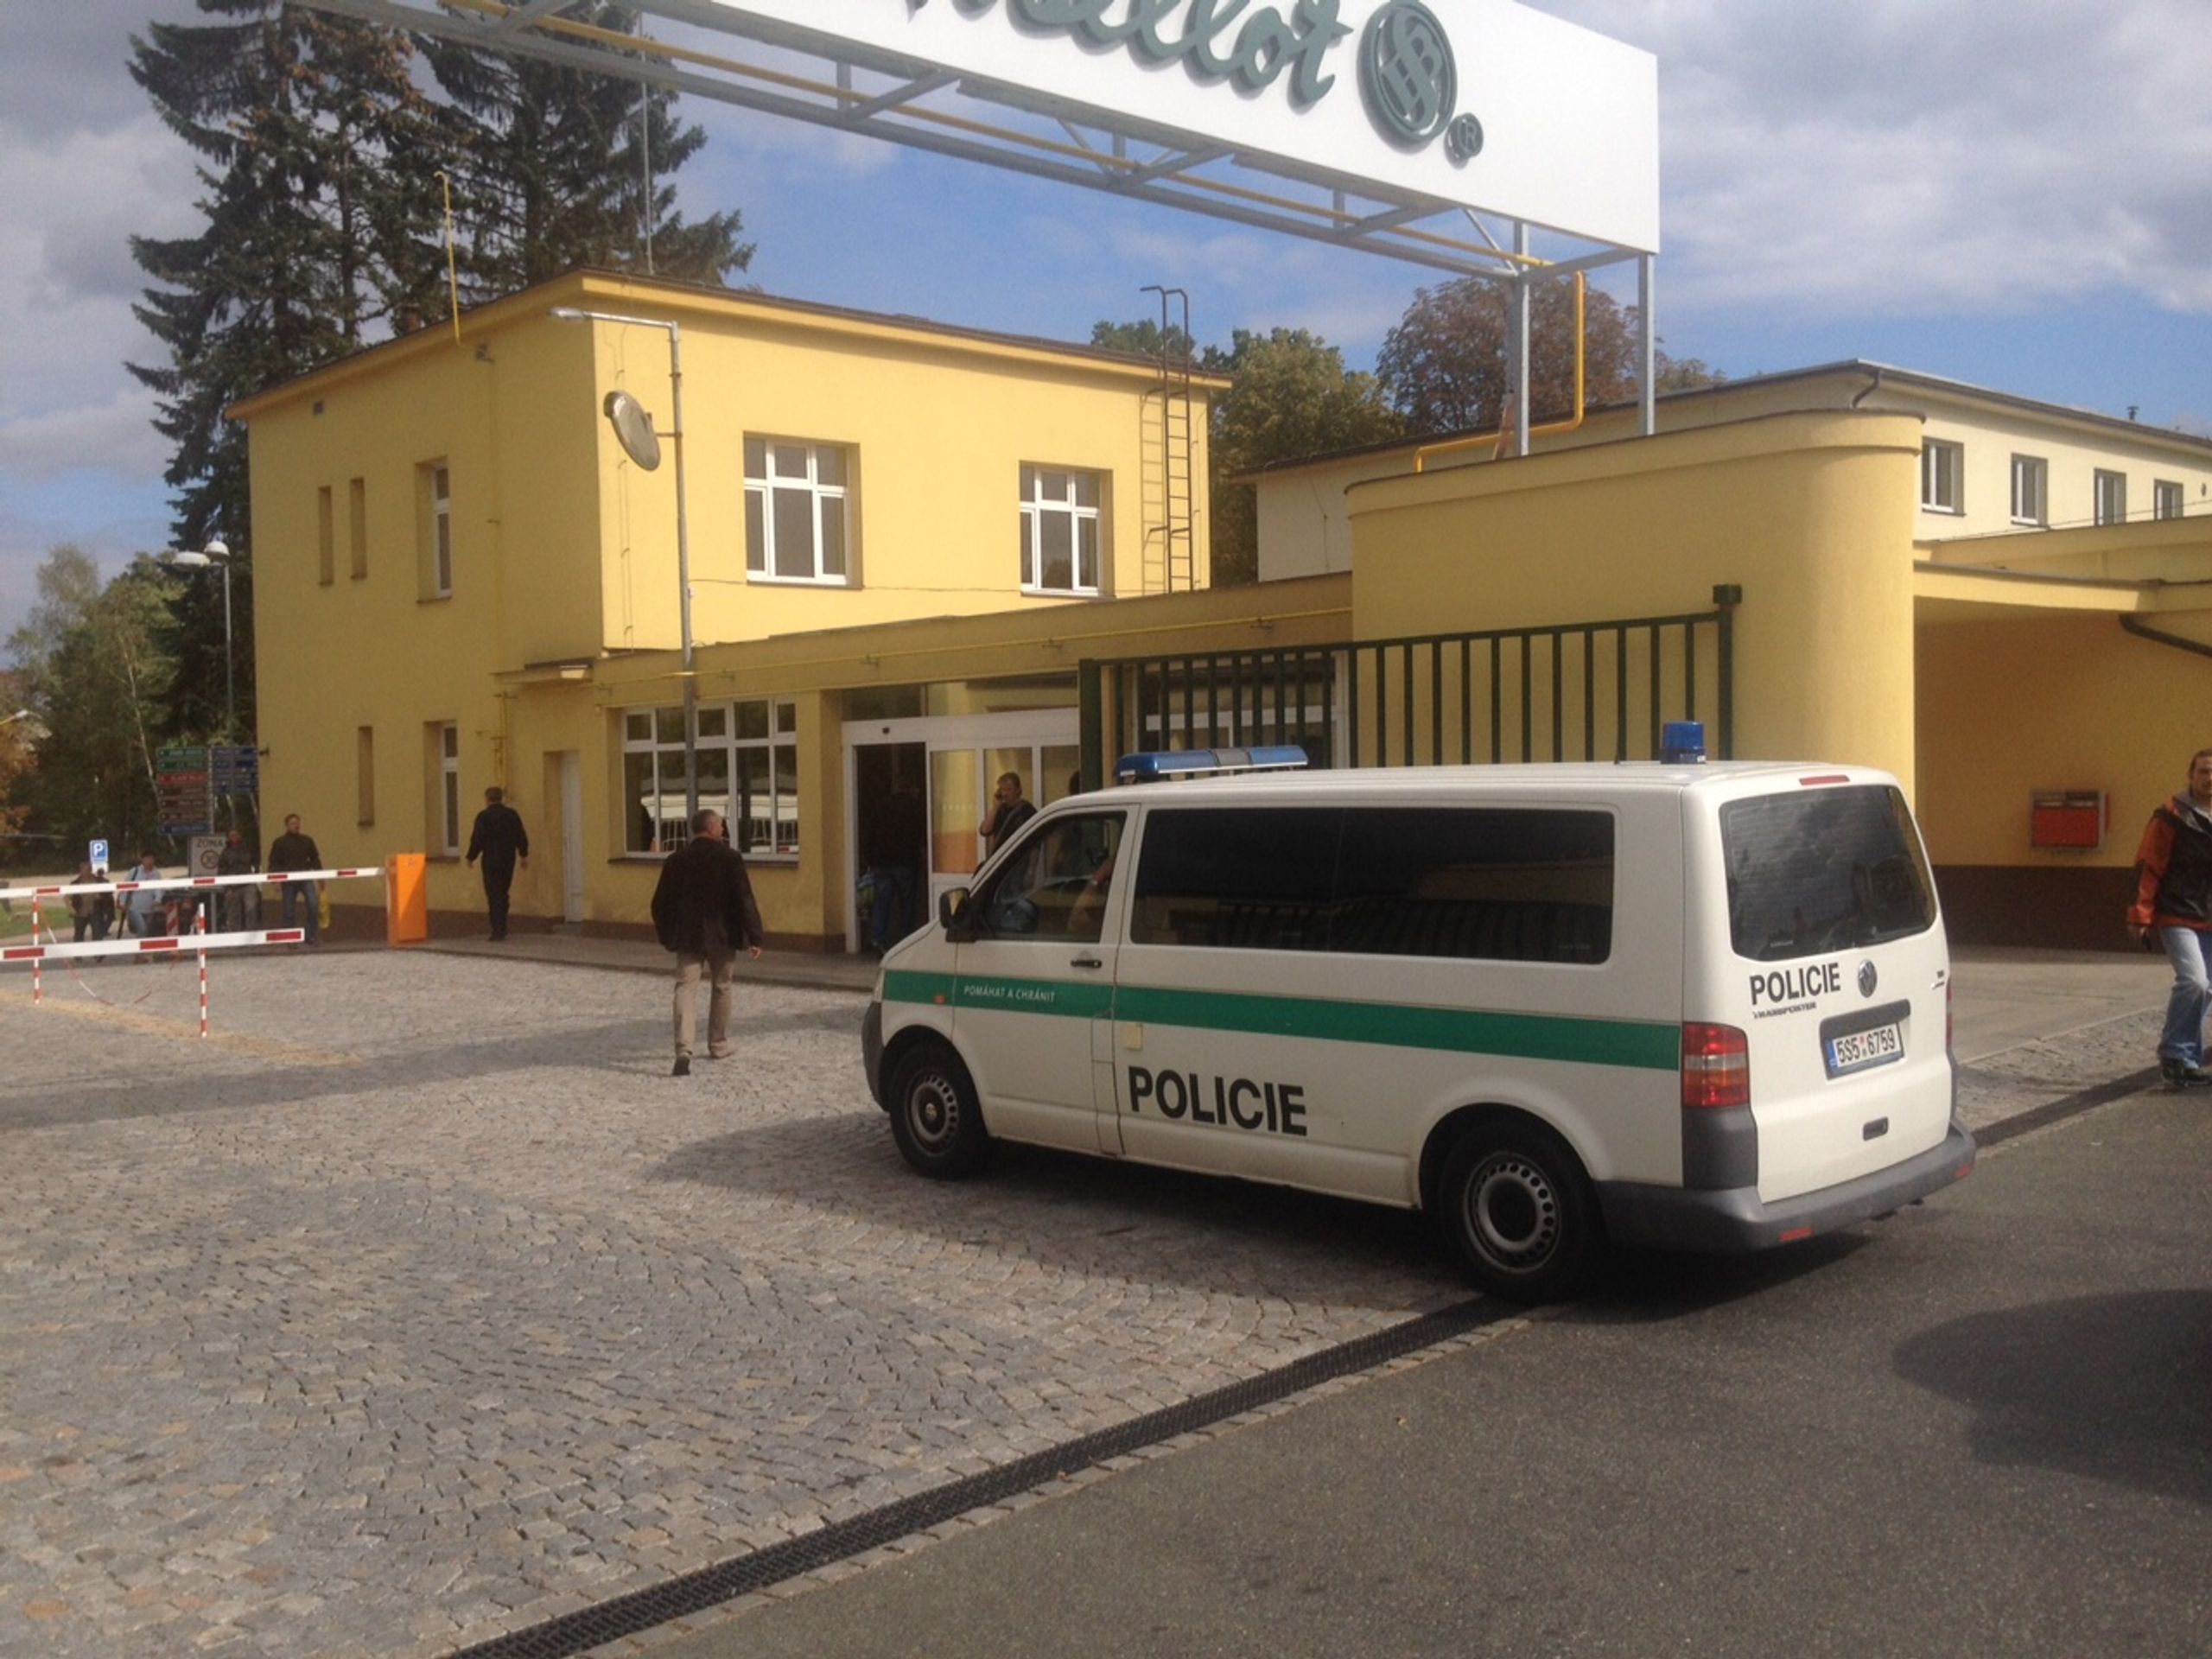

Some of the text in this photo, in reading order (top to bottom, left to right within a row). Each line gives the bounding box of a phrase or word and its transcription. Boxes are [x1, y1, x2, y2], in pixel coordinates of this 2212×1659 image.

[963, 984, 1005, 996] POMÁHAT
[1007, 988, 1014, 999] A
[1750, 963, 1840, 1005] POLICIE
[1836, 1028, 1895, 1063] 5S5 6759
[1128, 1065, 1306, 1136] POLICIE
